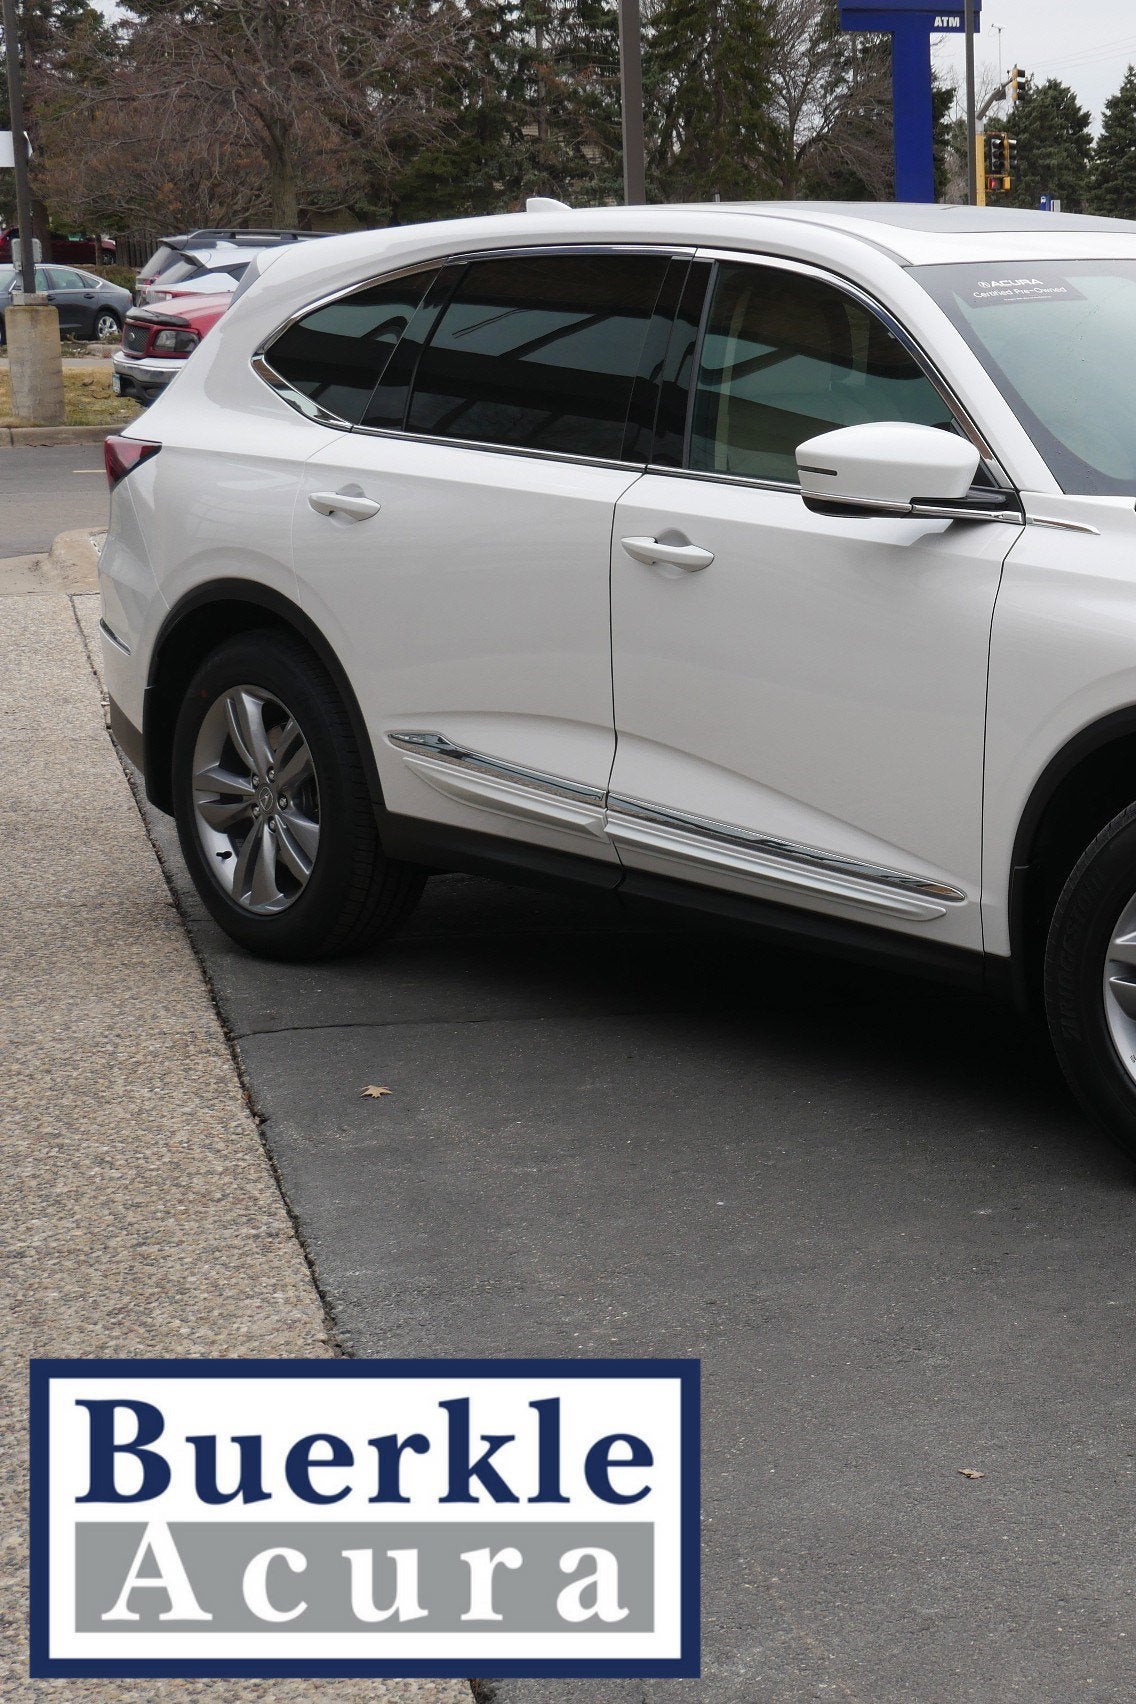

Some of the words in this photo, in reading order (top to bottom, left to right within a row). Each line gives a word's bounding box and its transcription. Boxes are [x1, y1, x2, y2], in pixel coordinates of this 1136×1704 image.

[934, 16, 960, 27] ATM
[992, 279, 1043, 287] ACURA
[973, 289, 1013, 298] Certified
[1013, 286, 1067, 295] Pre-Owned
